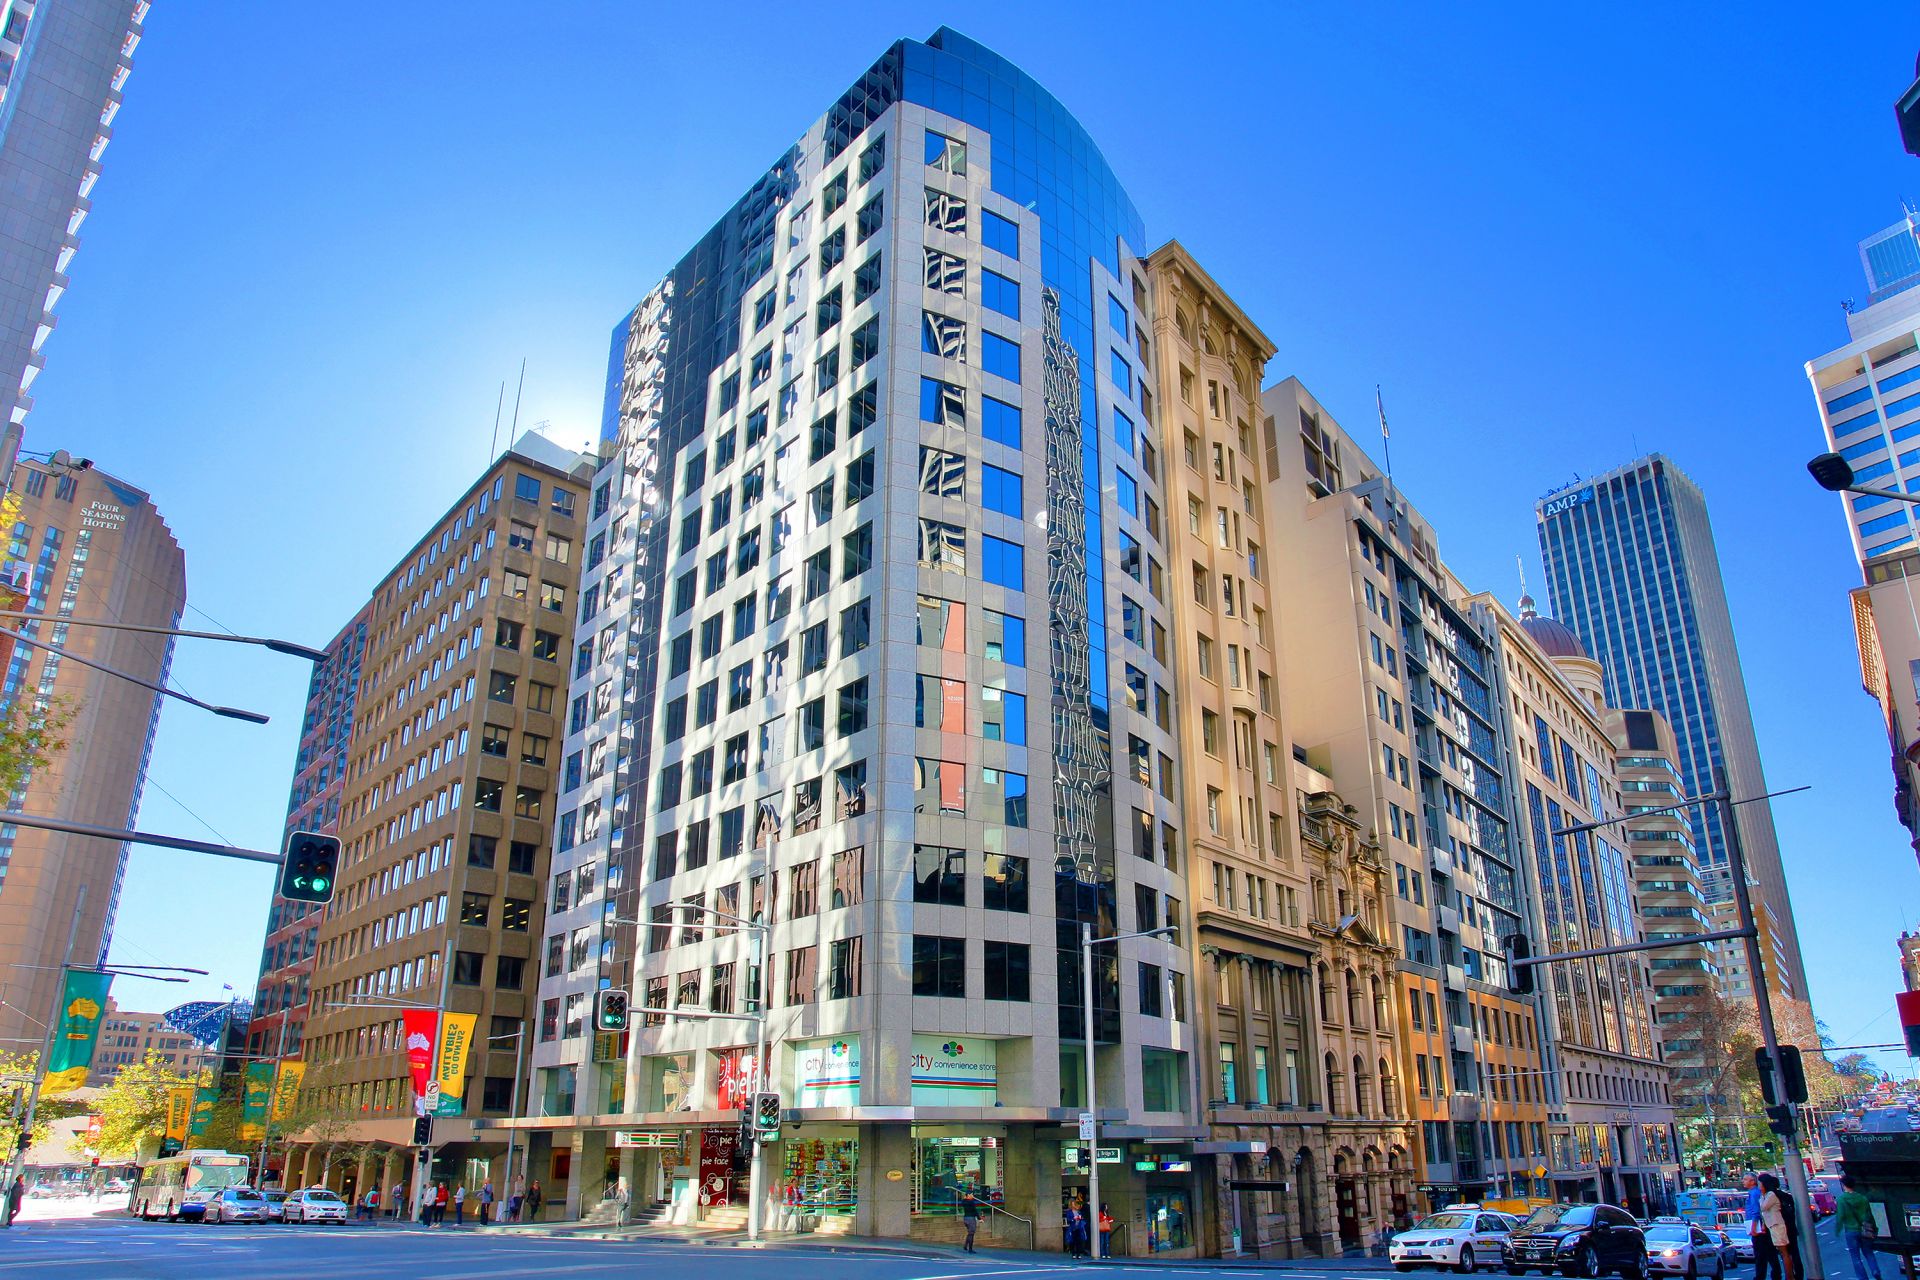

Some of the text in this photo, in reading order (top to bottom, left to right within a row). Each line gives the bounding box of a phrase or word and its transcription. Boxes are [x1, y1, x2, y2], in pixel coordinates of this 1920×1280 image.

[91, 501, 120, 513] FOUR
[1546, 494, 1578, 517] AMP
[80, 507, 126, 521] SEASONS
[82, 517, 120, 530] HOTEL
[805, 1057, 825, 1073] city
[934, 1061, 978, 1071] convenience
[978, 1063, 998, 1071] store
[728, 1069, 747, 1102] pie
[720, 1134, 733, 1146] pie
[1851, 1133, 1894, 1144] Telephone
[701, 1156, 729, 1167] pie face
[1067, 1152, 1078, 1161] cit
